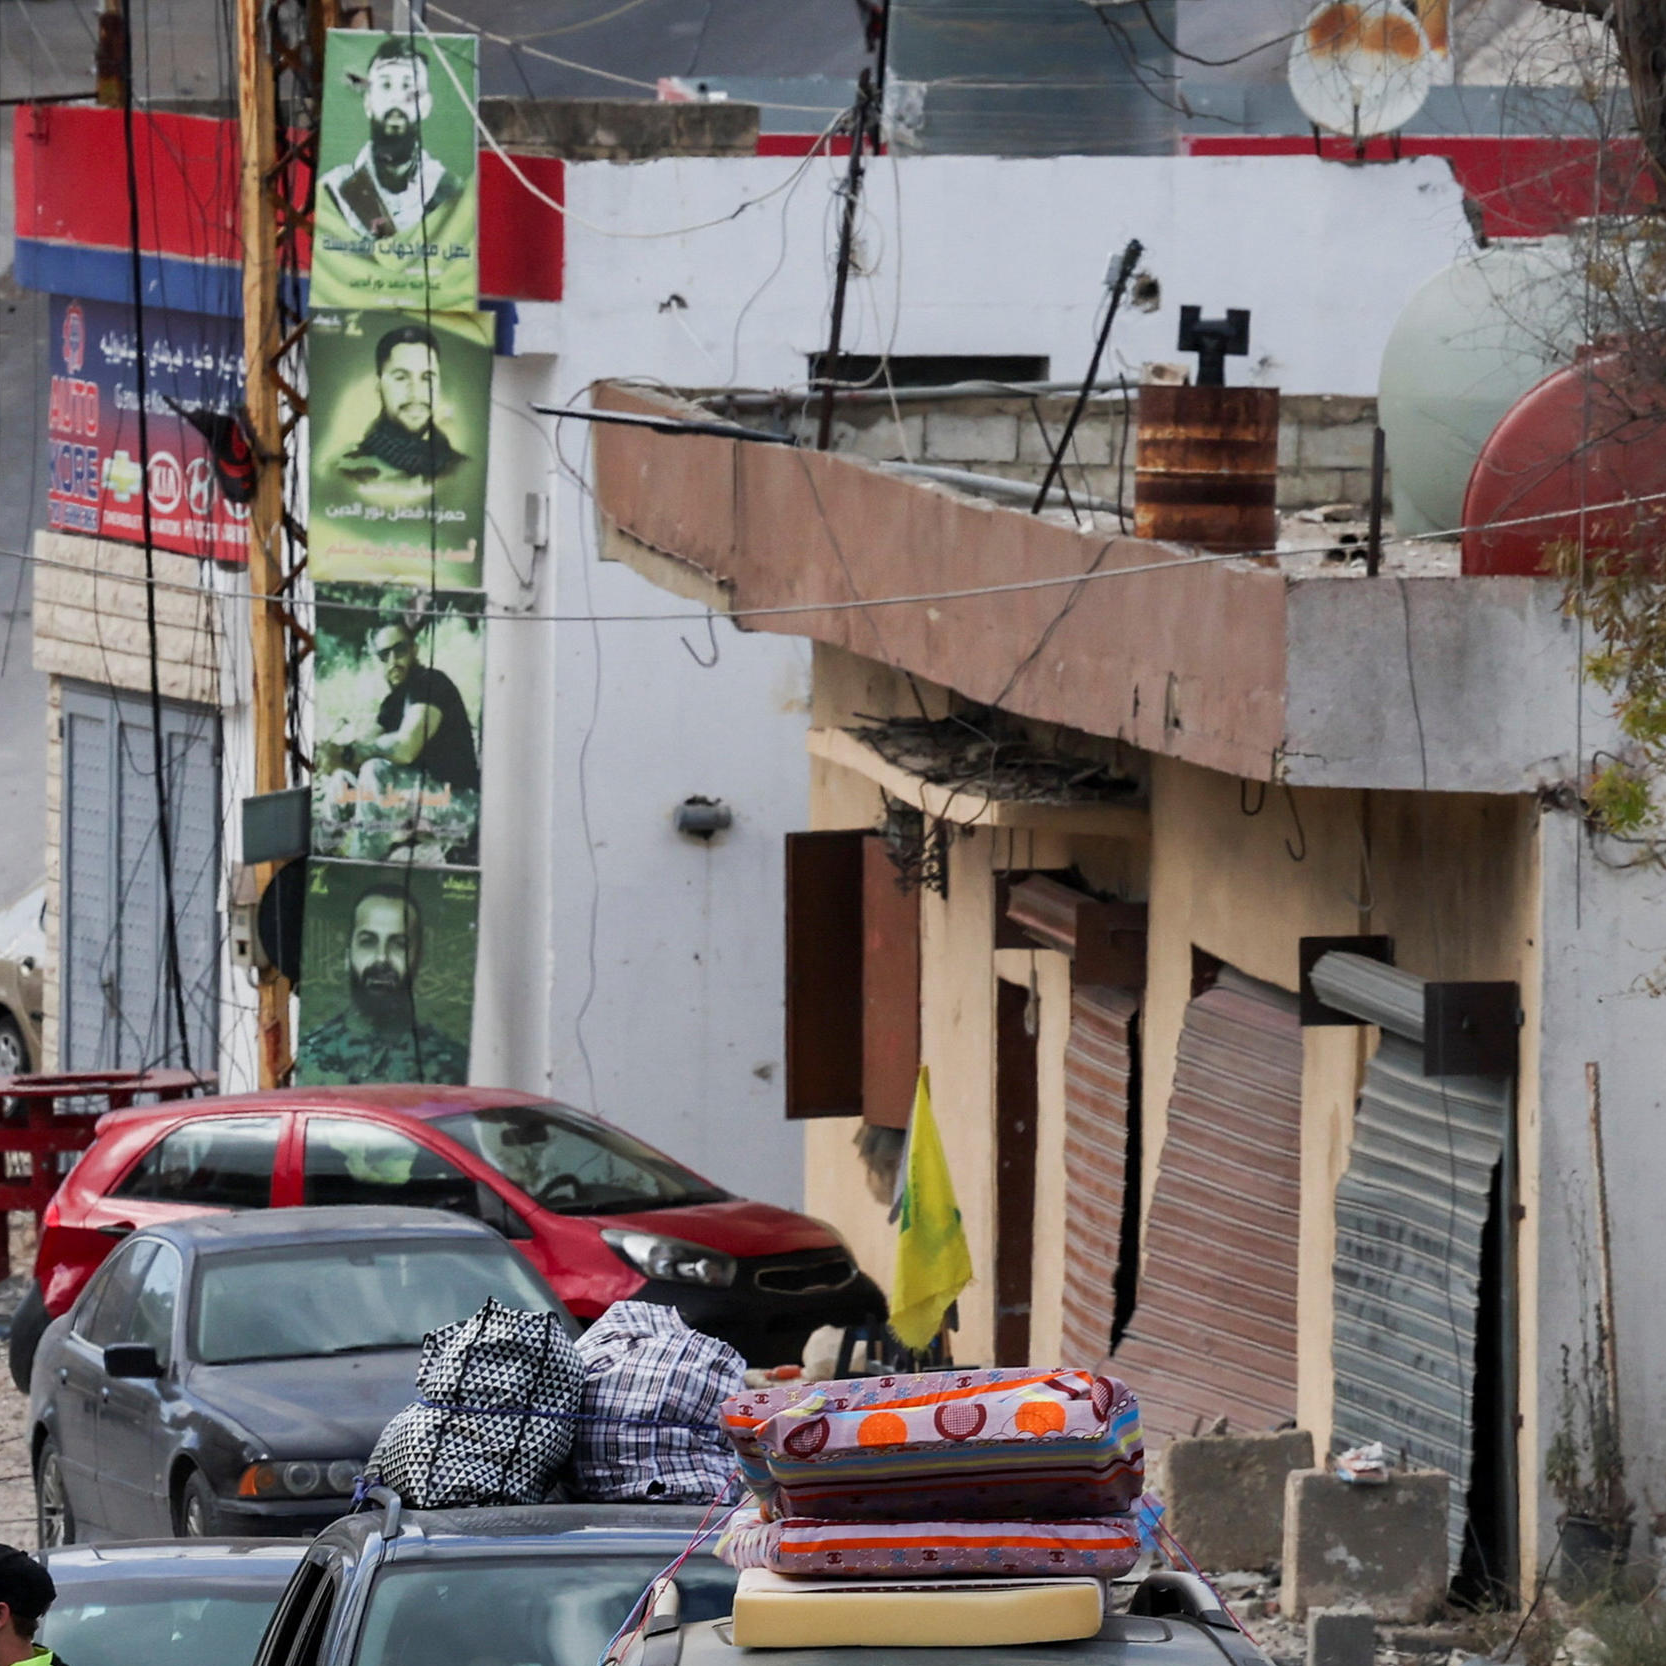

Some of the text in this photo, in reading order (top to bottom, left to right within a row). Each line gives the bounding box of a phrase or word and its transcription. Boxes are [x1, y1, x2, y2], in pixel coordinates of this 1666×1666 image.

[48, 374, 99, 437] AUTO
[151, 465, 176, 498] KIA
[325, 502, 361, 517] الدين
[364, 506, 384, 520] نور
[388, 504, 424, 521] فضل
